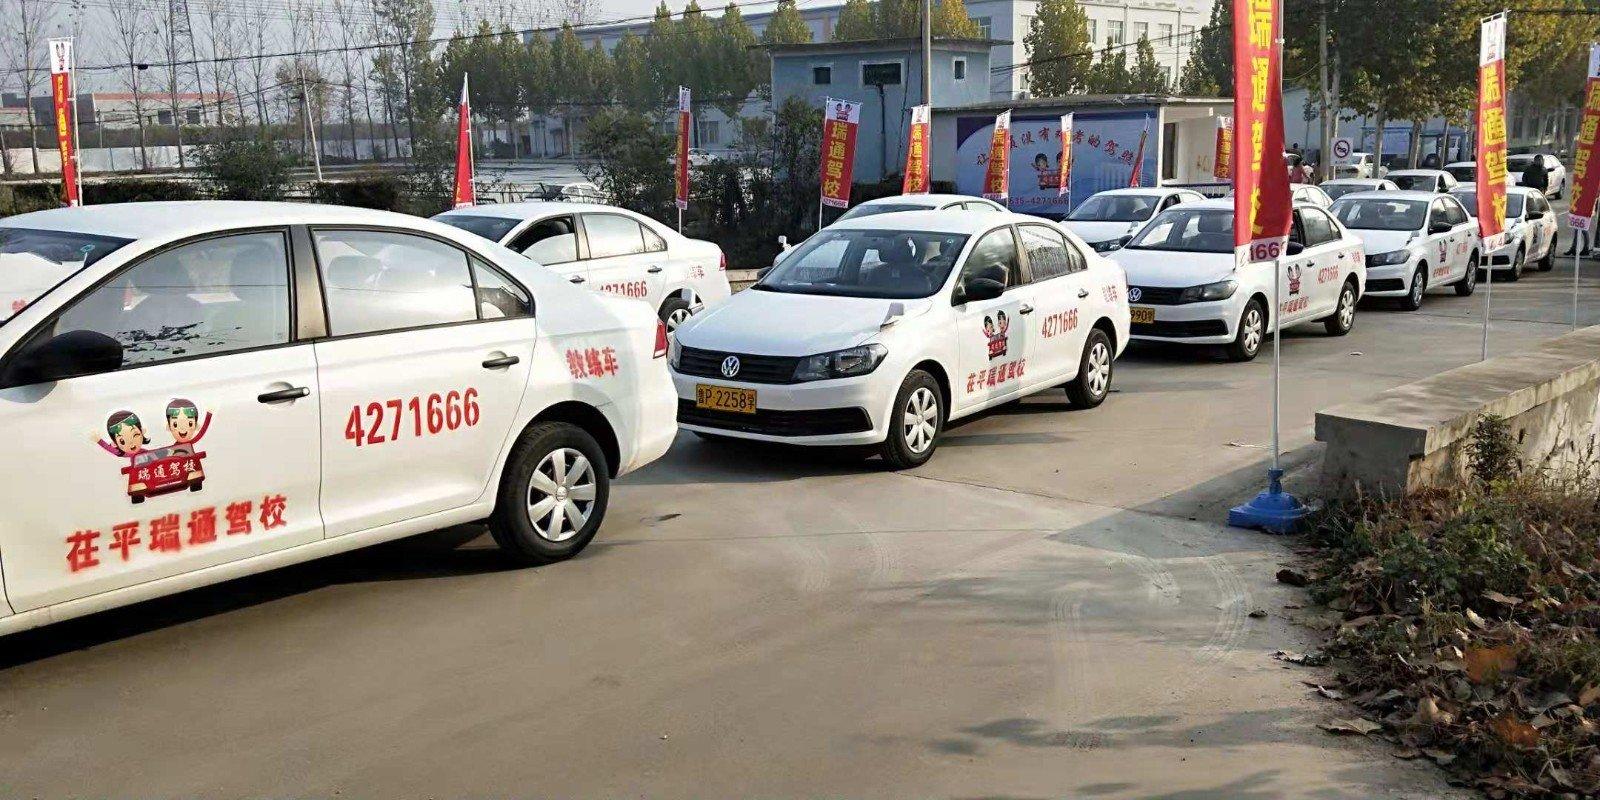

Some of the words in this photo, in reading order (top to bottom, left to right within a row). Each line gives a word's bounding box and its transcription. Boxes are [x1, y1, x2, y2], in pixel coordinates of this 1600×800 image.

[823, 122, 849, 198] 瑞通驾校
[1041, 308, 1078, 338] 4271666
[345, 387, 480, 447] 4271666
[138, 459, 196, 480] 瑞通驾校
[66, 494, 288, 573] 茌平瑞通驾校
